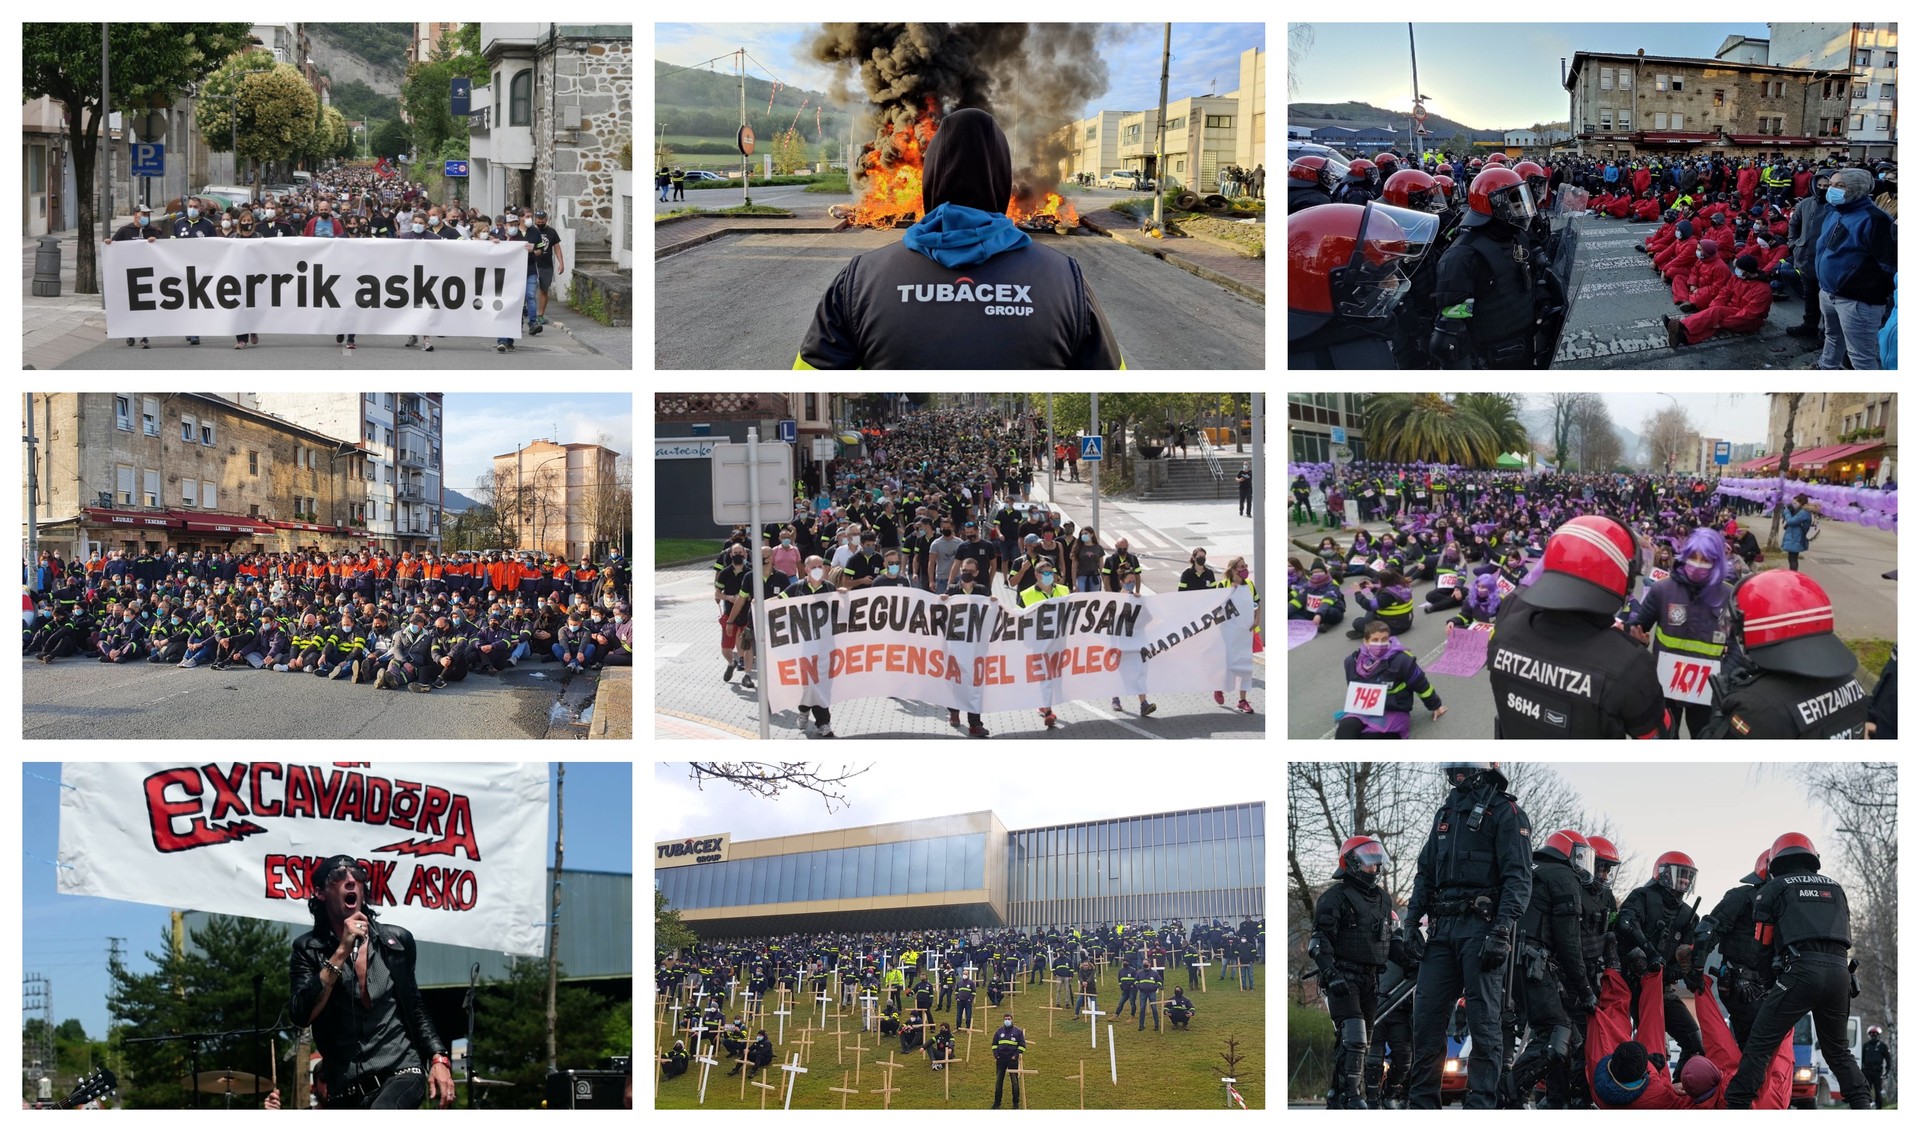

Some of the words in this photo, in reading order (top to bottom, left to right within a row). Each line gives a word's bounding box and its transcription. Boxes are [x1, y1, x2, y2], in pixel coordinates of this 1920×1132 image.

[138, 144, 155, 166] P
[126, 260, 341, 311] Eskerrik
[354, 264, 506, 311] asko!!
[897, 283, 1033, 303] TUBACEX
[984, 305, 1034, 316] GROUP
[112, 516, 134, 524] LAURAK
[768, 595, 989, 648] ENPLEGUAREN
[989, 600, 1142, 643] DEFENTSAN
[777, 654, 819, 686] EN
[828, 643, 962, 685] DEFENSA
[973, 655, 1015, 687] DEL
[1025, 645, 1122, 683] EMPLEO
[1493, 648, 1592, 698] ERTZAINTZA
[1669, 661, 1712, 697] 101
[1354, 687, 1382, 710] 148
[1507, 692, 1541, 720] S6H4
[143, 761, 482, 862] EXCAVADORA
[657, 838, 724, 859] TUBACEX
[696, 854, 722, 863] GROUP
[404, 864, 478, 911] ASKO
[1799, 889, 1820, 897] A6K2
